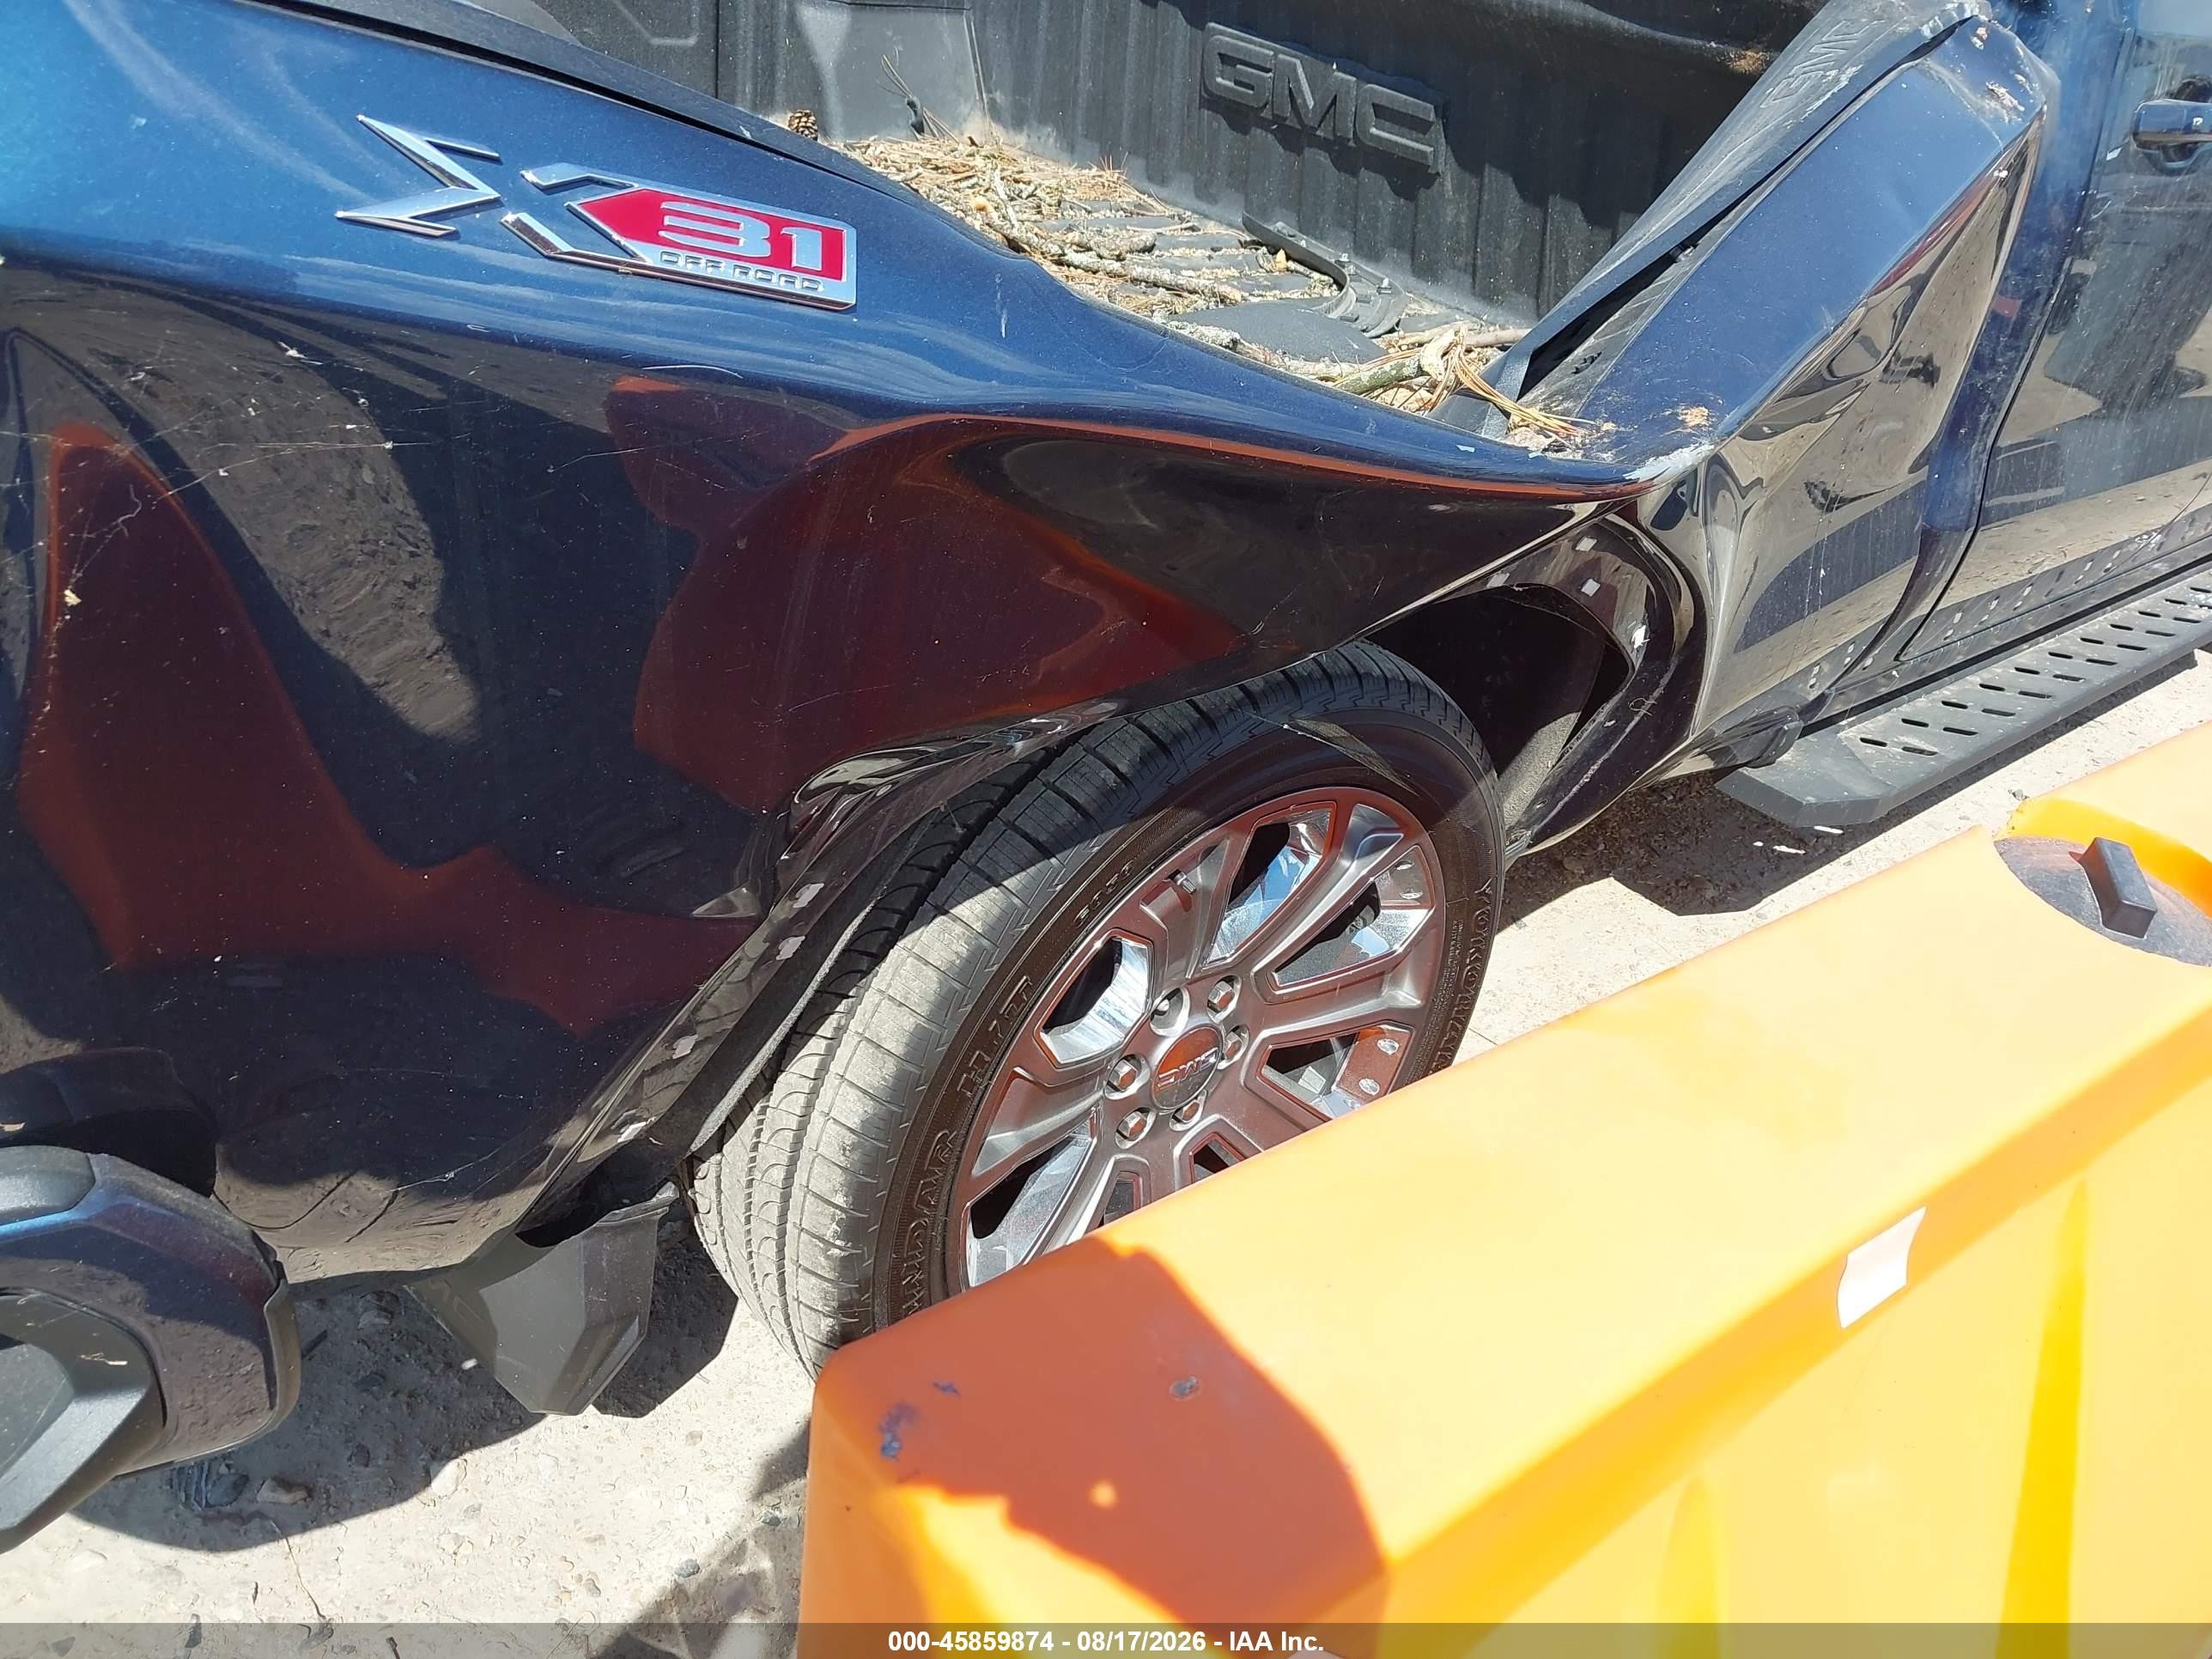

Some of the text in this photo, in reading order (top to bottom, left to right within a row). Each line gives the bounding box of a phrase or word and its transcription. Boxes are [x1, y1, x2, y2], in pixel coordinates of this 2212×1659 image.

[1203, 34, 1435, 167] GMC
[1759, 20, 1886, 108] GMC
[659, 250, 825, 293] OFF ROAD
